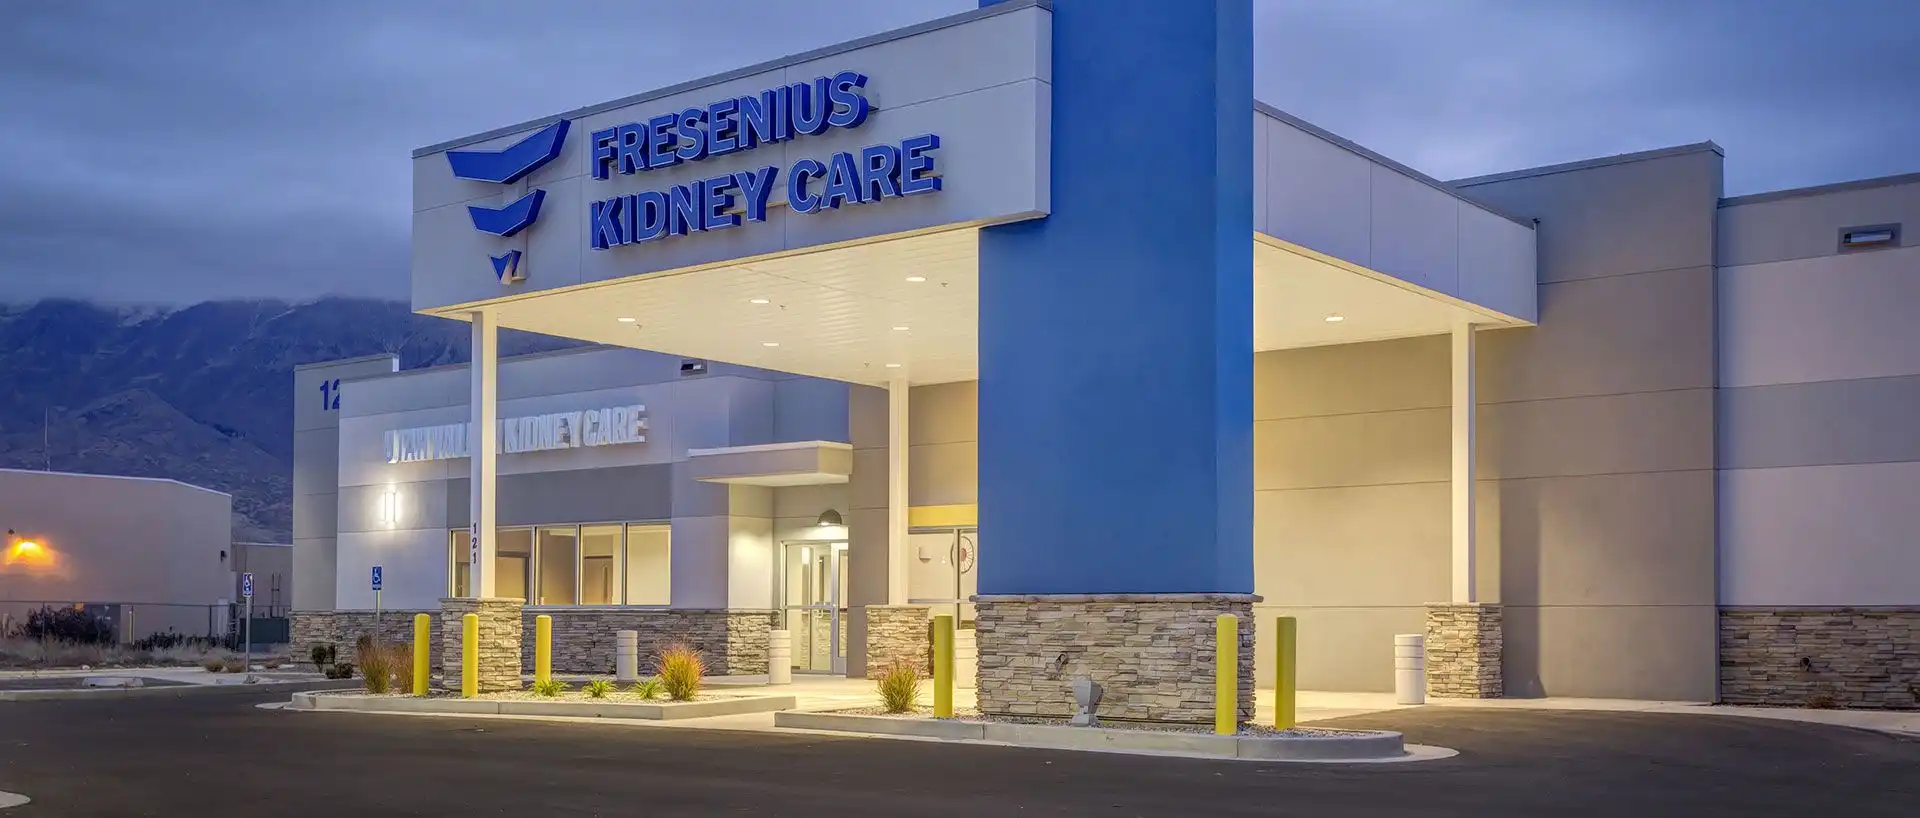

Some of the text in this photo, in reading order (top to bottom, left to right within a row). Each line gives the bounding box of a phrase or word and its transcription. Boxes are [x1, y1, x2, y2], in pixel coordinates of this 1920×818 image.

[590, 70, 868, 180] FRESENIUS
[590, 132, 942, 250] KIDNEY CARE
[504, 411, 582, 454] KIDNEY
[583, 404, 648, 447] CARE
